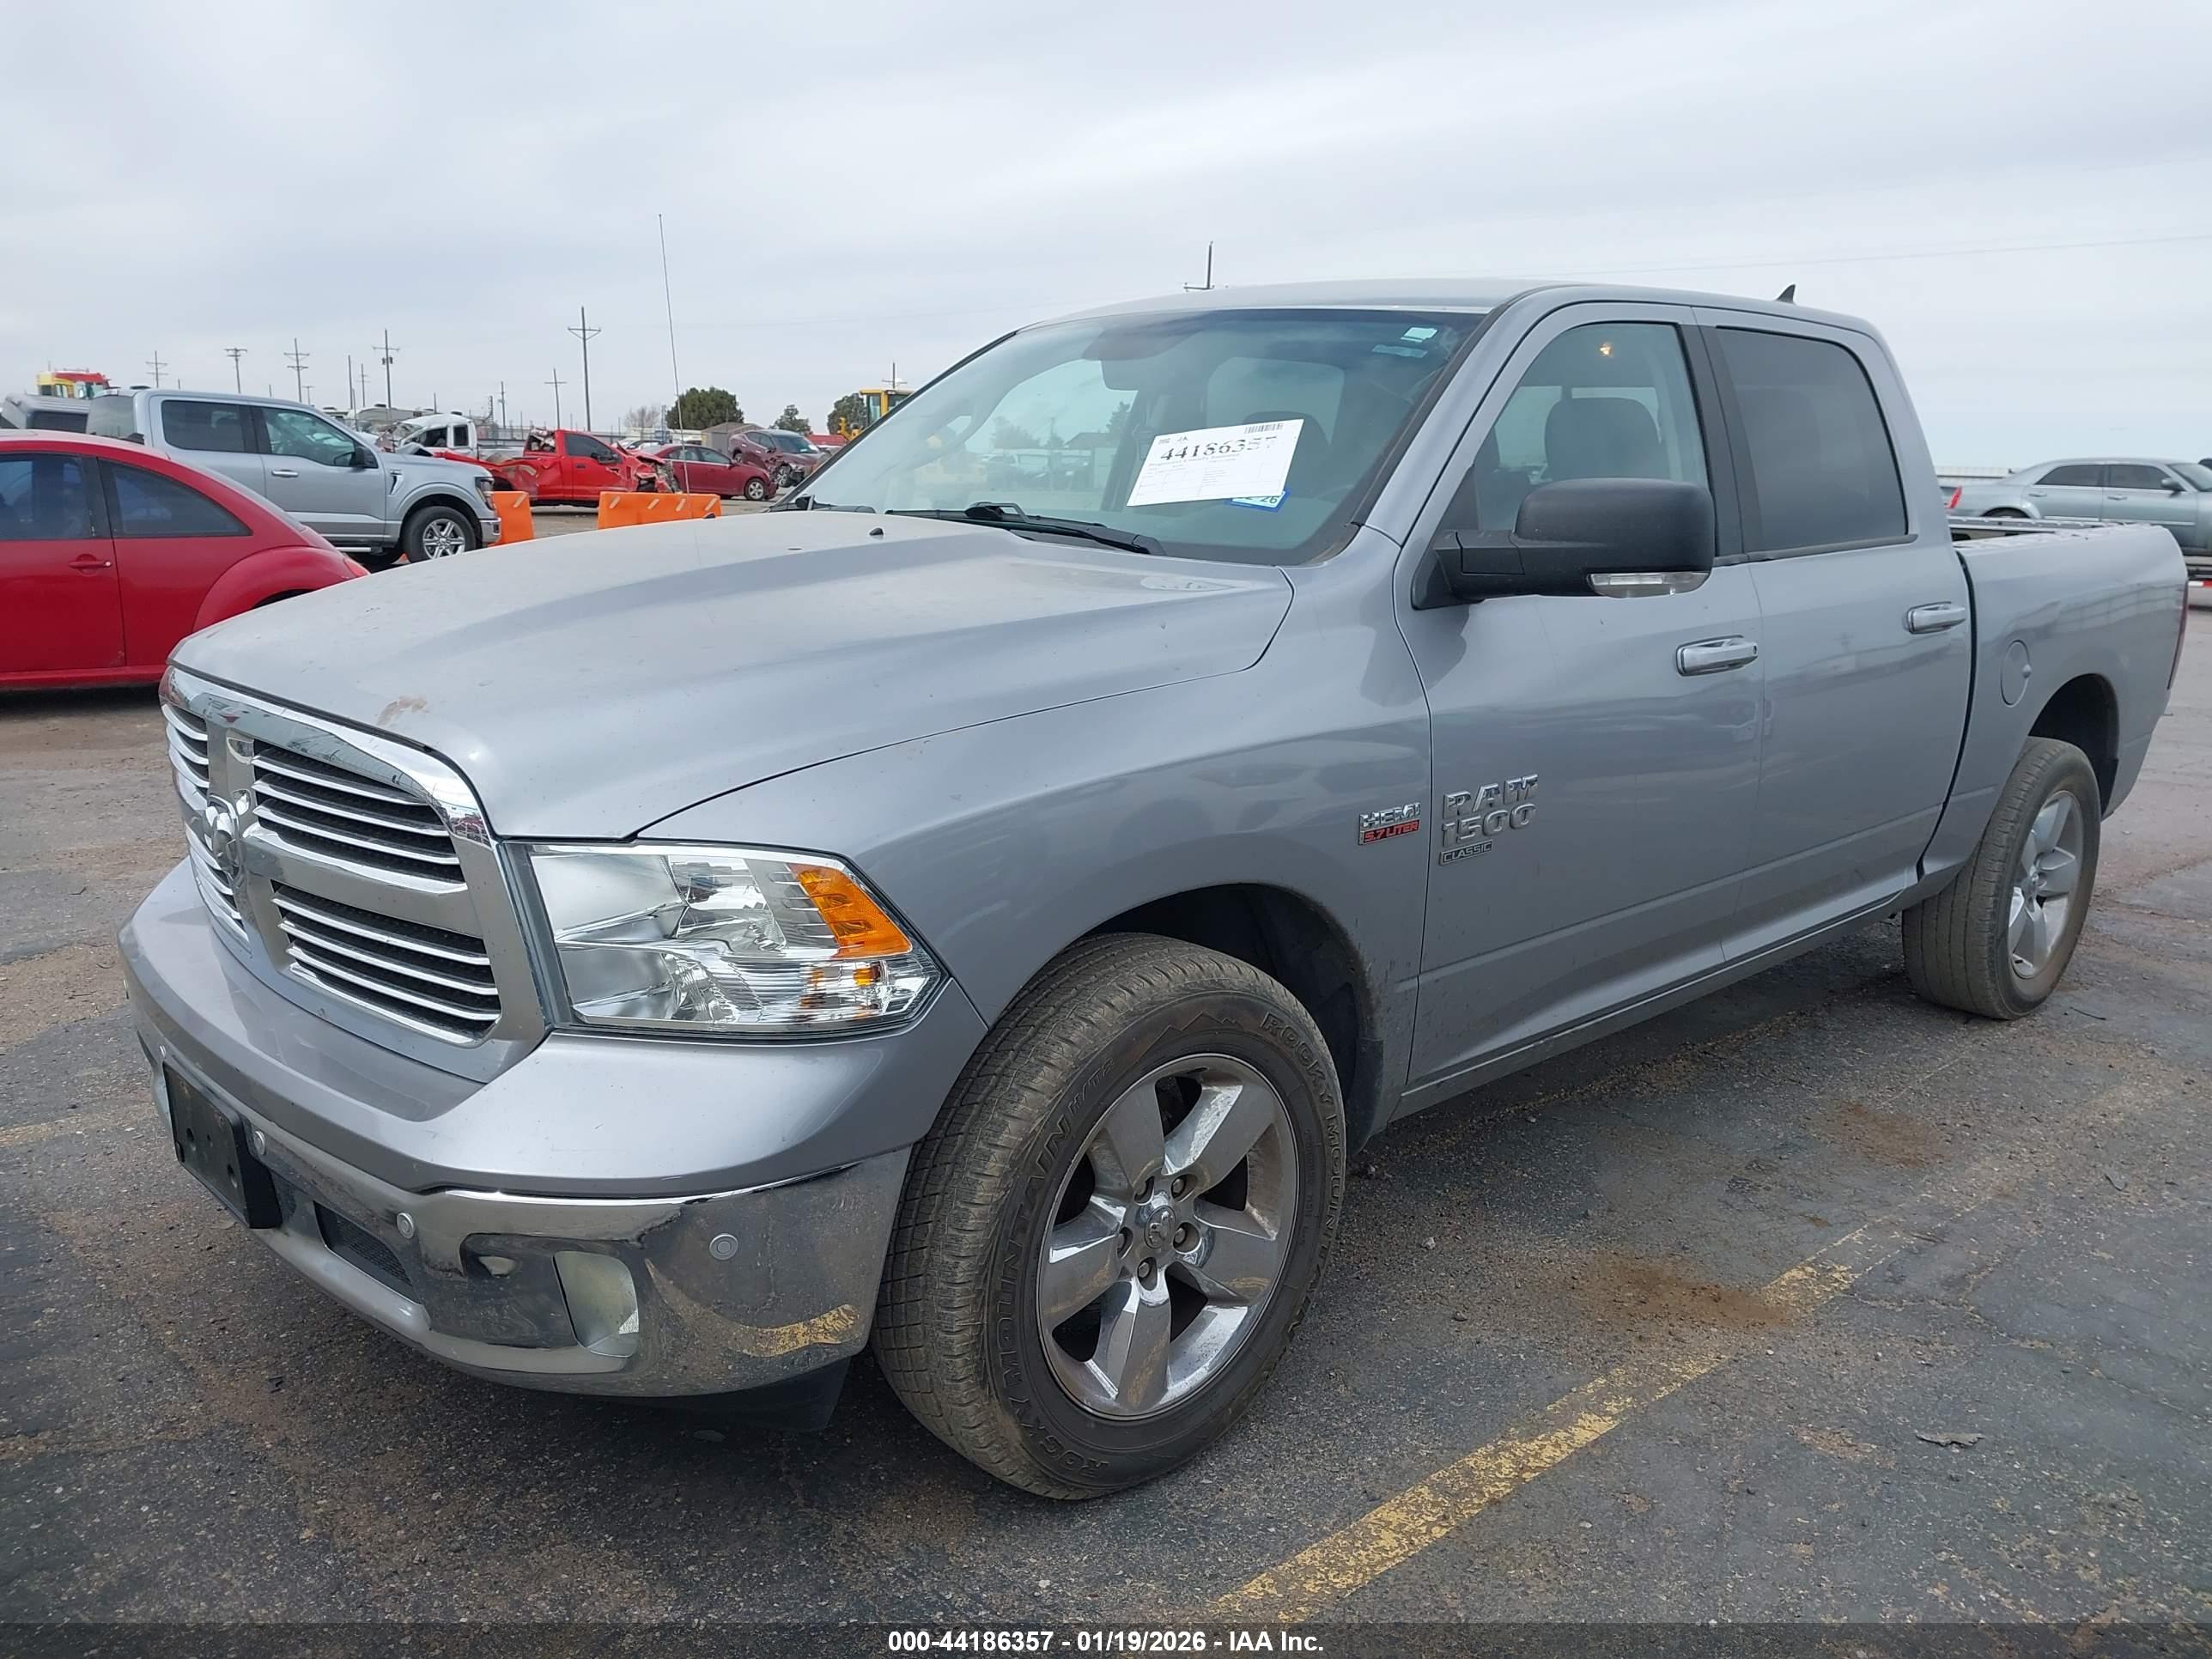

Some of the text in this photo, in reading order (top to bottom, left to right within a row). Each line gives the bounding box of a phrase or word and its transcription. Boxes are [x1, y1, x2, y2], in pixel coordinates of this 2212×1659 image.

[1359, 802, 1421, 830] HEMI
[1443, 774, 1539, 819] RAM
[1364, 821, 1419, 842] 5.7 LITER
[1442, 804, 1536, 848] 1500
[1443, 842, 1492, 862] CLASSIC
[1260, 1012, 1334, 1104] ROCKY
[996, 1114, 1072, 1389] MOUNTAIN
